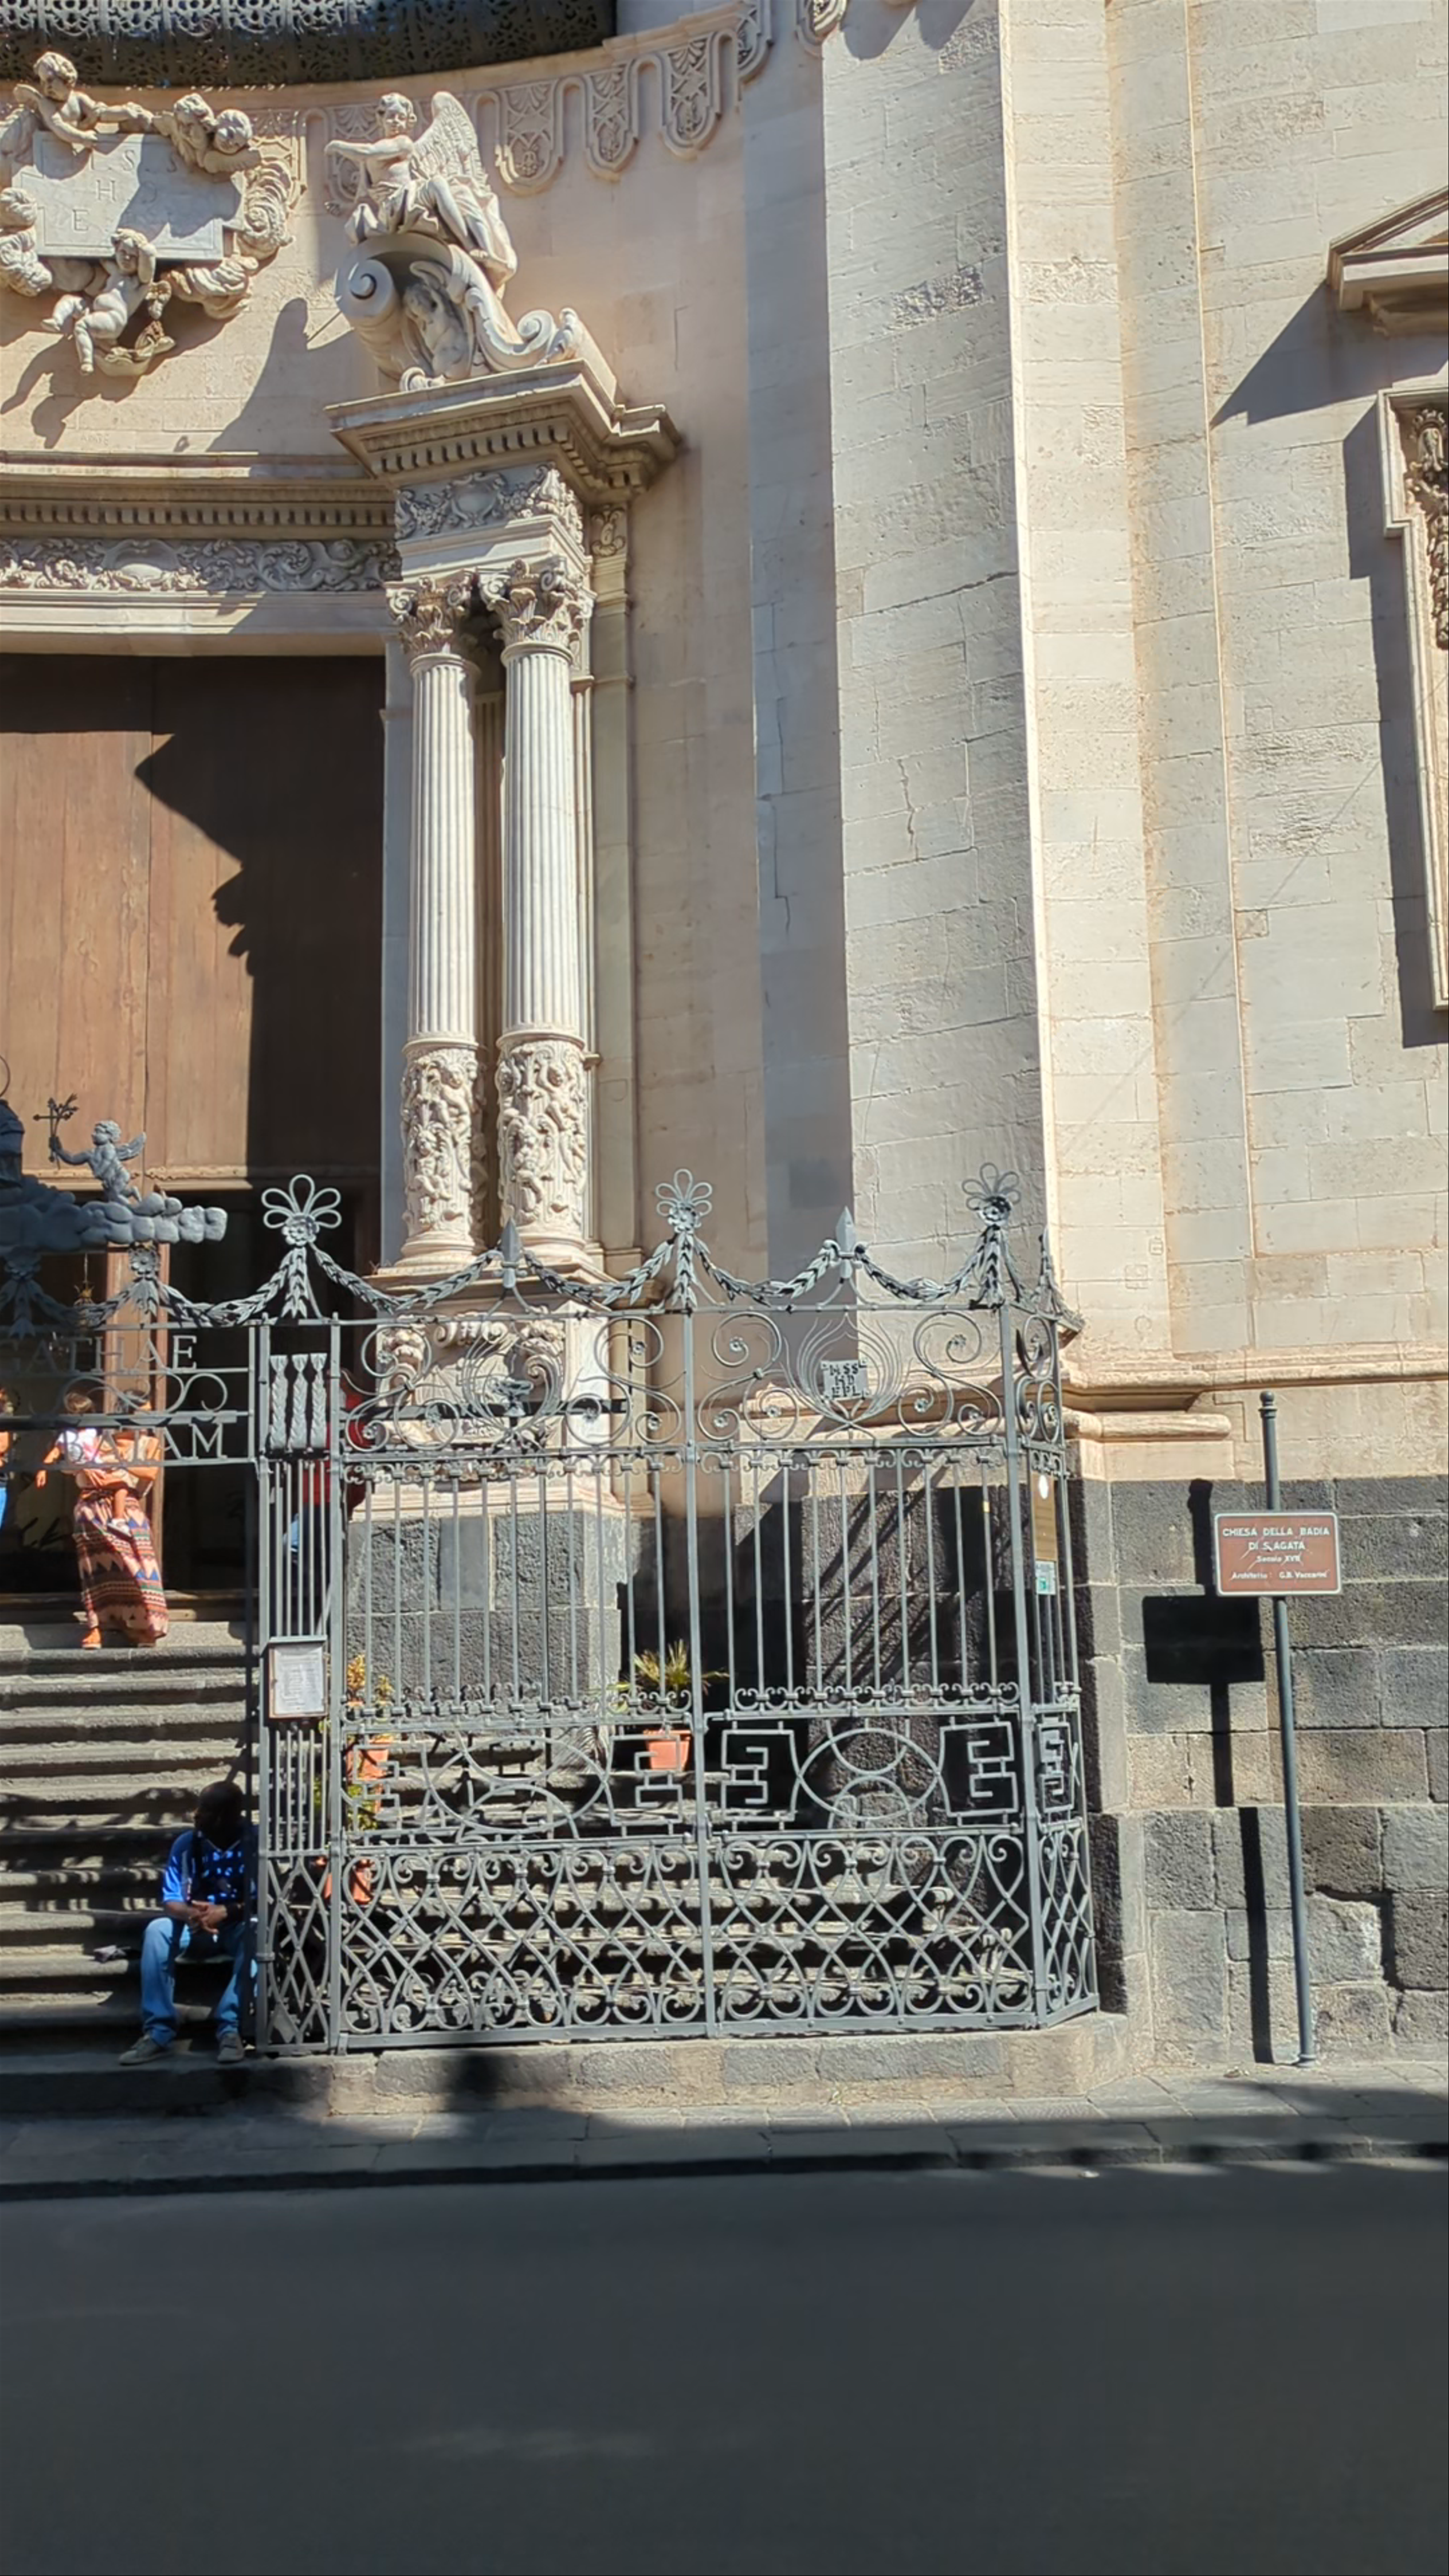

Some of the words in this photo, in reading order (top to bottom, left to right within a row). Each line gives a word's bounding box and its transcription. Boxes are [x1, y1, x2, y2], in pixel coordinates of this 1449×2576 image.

[1223, 1527, 1258, 1536] CHIESA
[1263, 1527, 1293, 1536] DELLA
[1300, 1527, 1330, 1535] BADIA
[1248, 1542, 1258, 1550] DI
